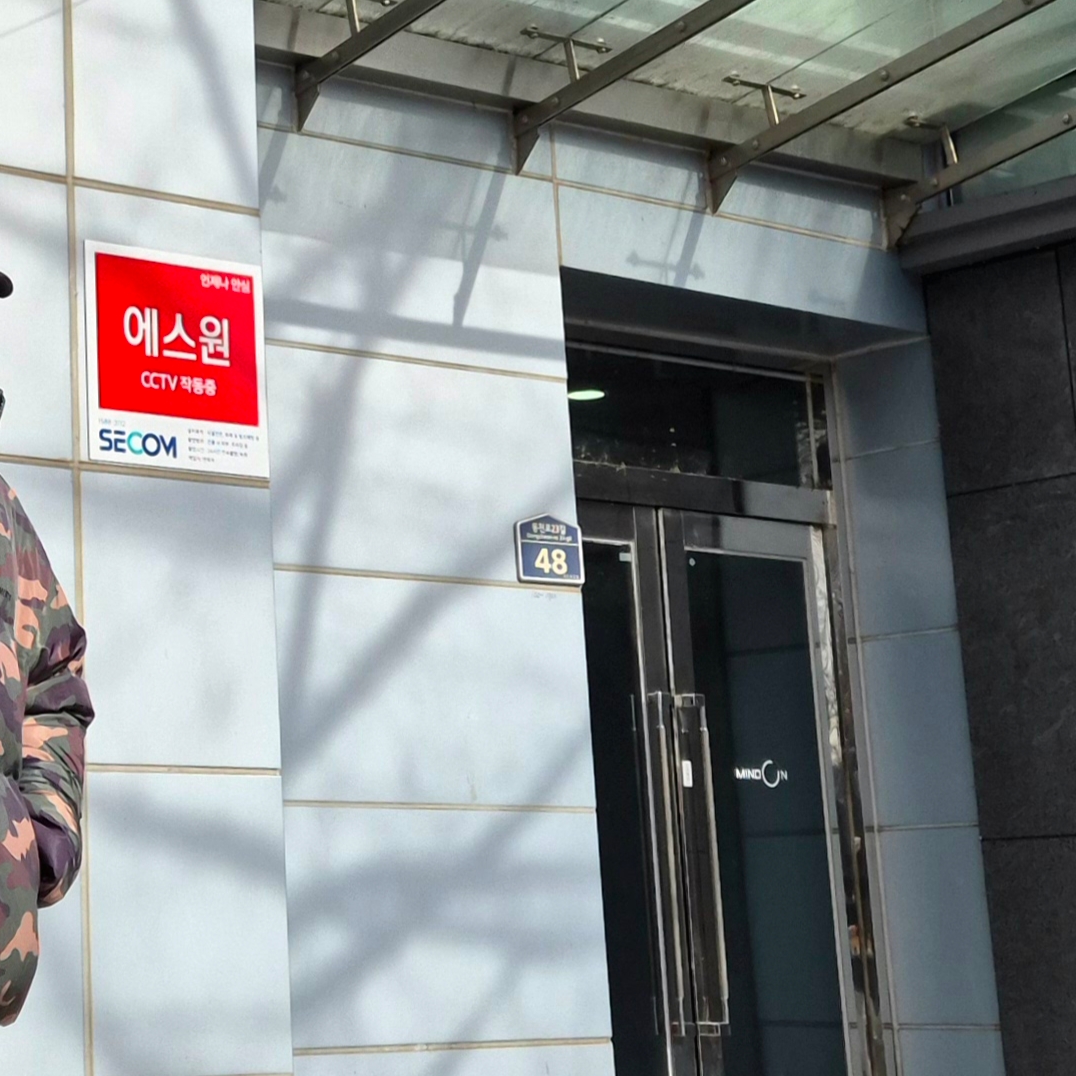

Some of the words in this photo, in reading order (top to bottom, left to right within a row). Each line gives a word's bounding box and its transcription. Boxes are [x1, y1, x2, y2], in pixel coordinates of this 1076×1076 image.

[200, 273, 229, 291] 언제나
[123, 305, 230, 367] 에스원
[141, 371, 178, 391] CCTV
[180, 375, 217, 396] 작동중
[99, 428, 177, 459] SECOM
[535, 548, 568, 575] 48
